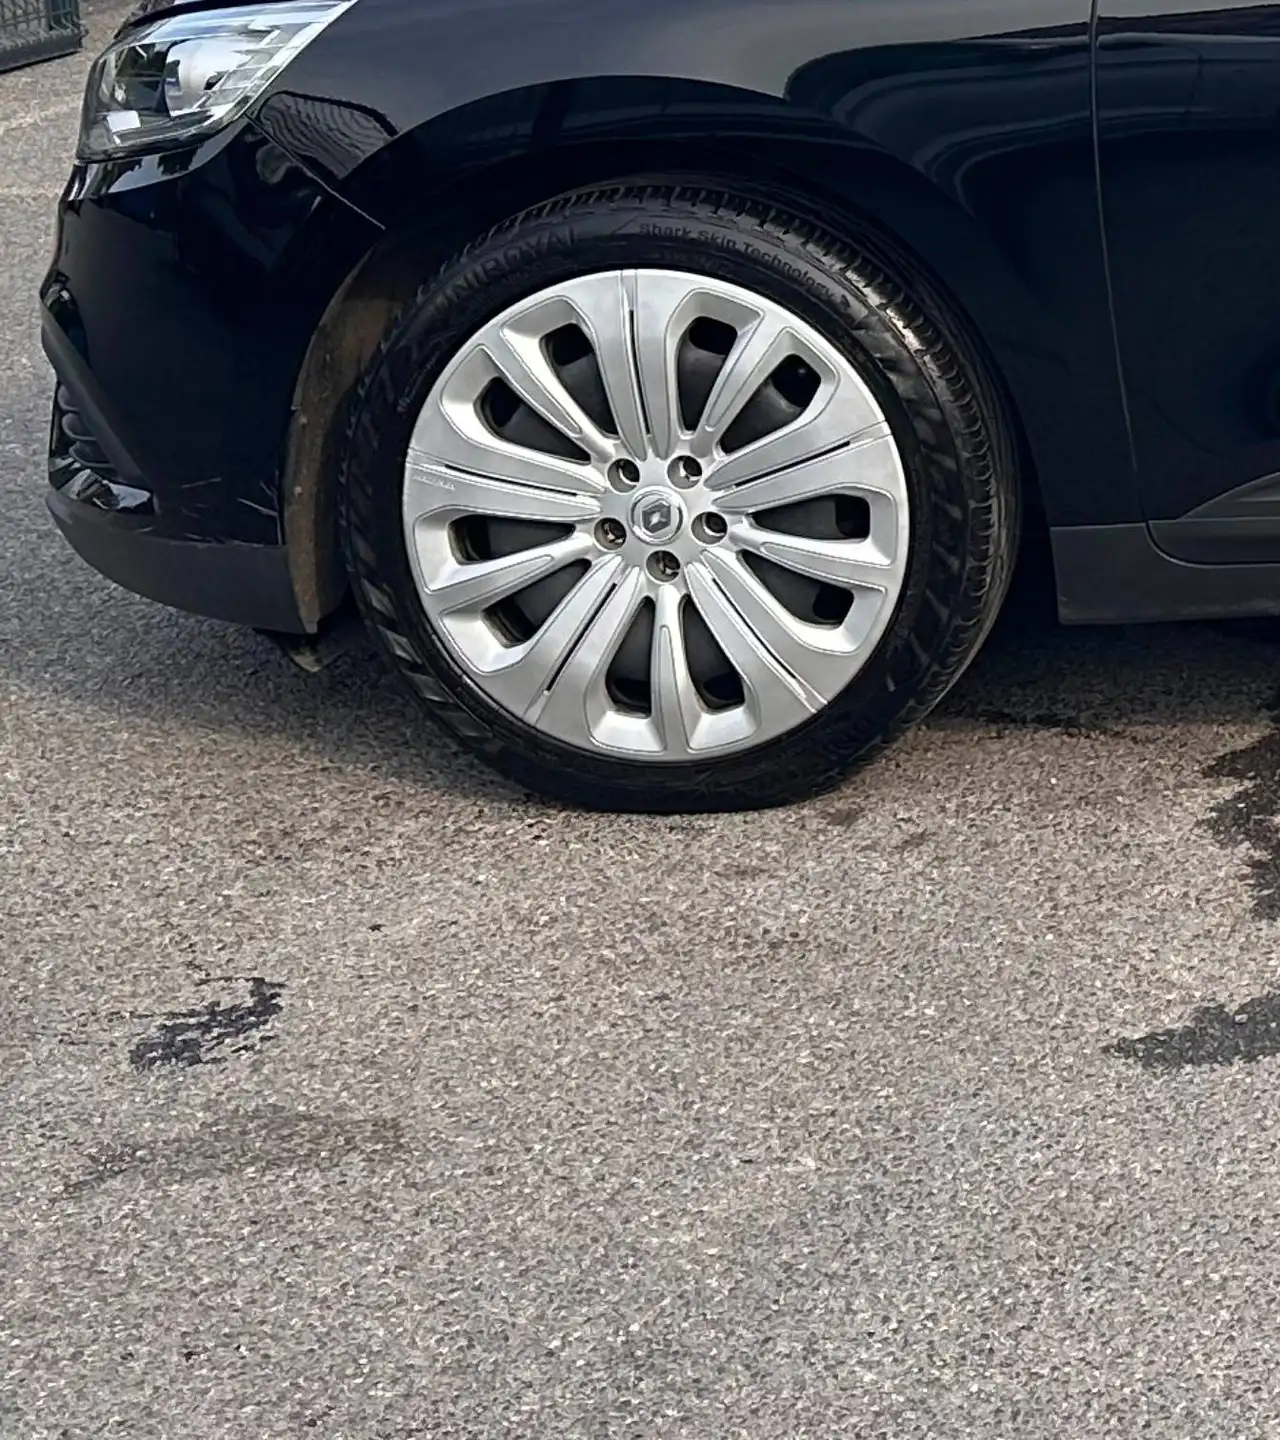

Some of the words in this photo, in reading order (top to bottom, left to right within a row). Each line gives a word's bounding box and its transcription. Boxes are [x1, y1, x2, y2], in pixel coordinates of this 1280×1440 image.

[638, 221, 694, 240] Shark
[696, 229, 739, 251] Skin
[741, 241, 840, 302] Technology
